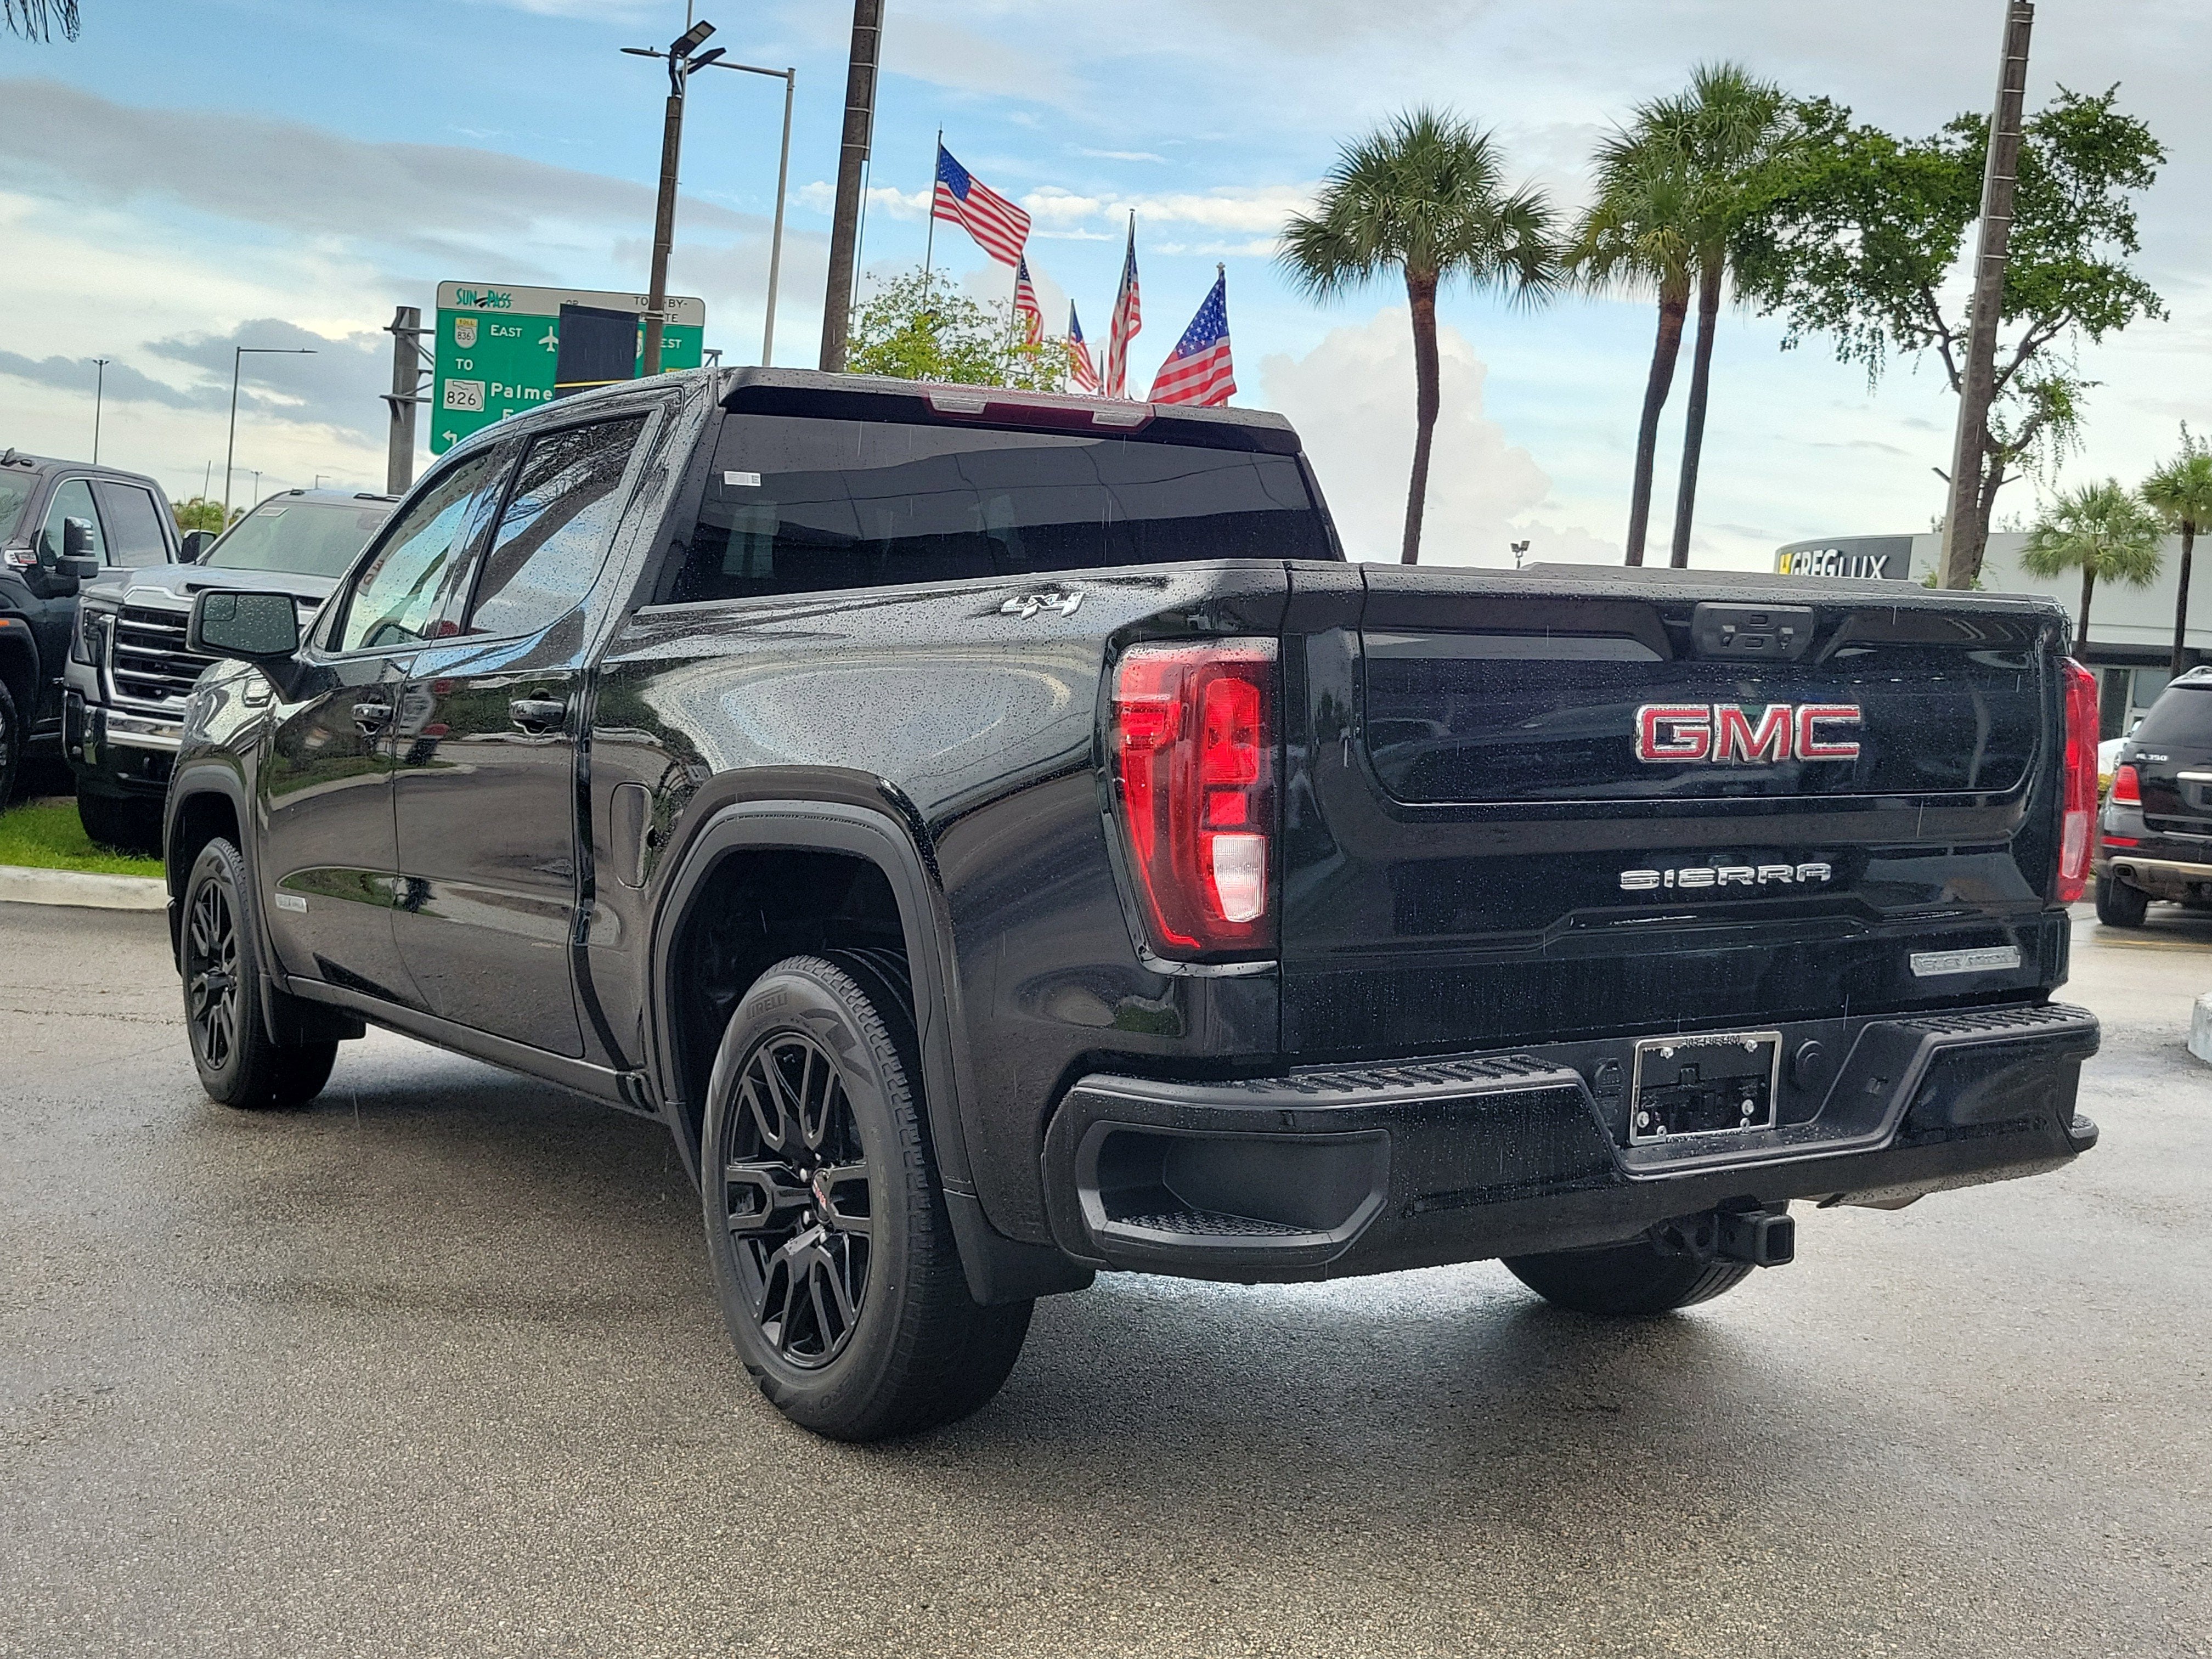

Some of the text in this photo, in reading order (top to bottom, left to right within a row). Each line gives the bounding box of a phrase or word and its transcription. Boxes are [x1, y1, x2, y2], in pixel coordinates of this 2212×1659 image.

[456, 288, 512, 308] SUN PASS
[457, 331, 471, 341] 836
[490, 324, 522, 338] EAST
[660, 338, 682, 349] EST
[455, 358, 473, 371] TO
[446, 392, 476, 406] 826
[1635, 703, 1861, 764] GMC
[1619, 862, 1832, 890] SIERRA
